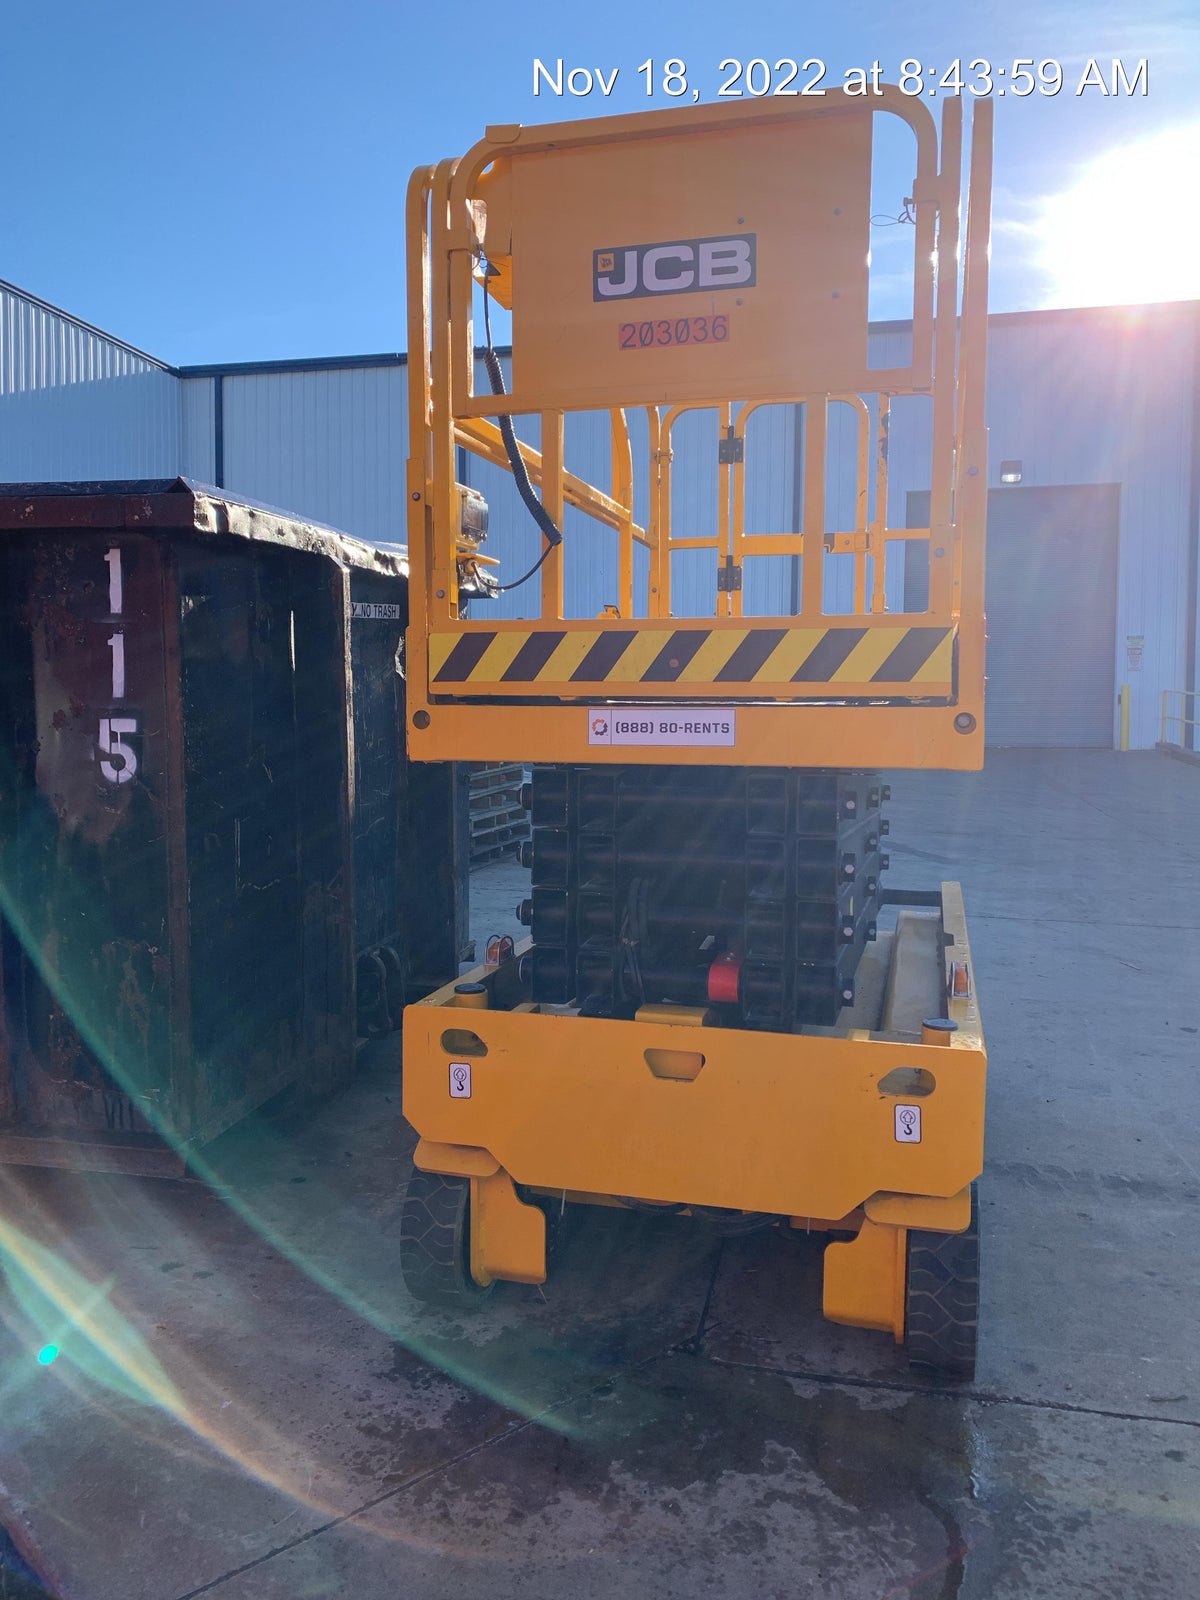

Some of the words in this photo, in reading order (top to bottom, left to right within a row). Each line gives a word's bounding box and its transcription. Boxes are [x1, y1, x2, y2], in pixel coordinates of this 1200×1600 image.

[597, 239, 752, 296] JCB
[620, 315, 728, 348] 203036
[374, 605, 396, 618] TRASH
[615, 721, 654, 734] (888)
[659, 722, 730, 734] 80-RENTS
